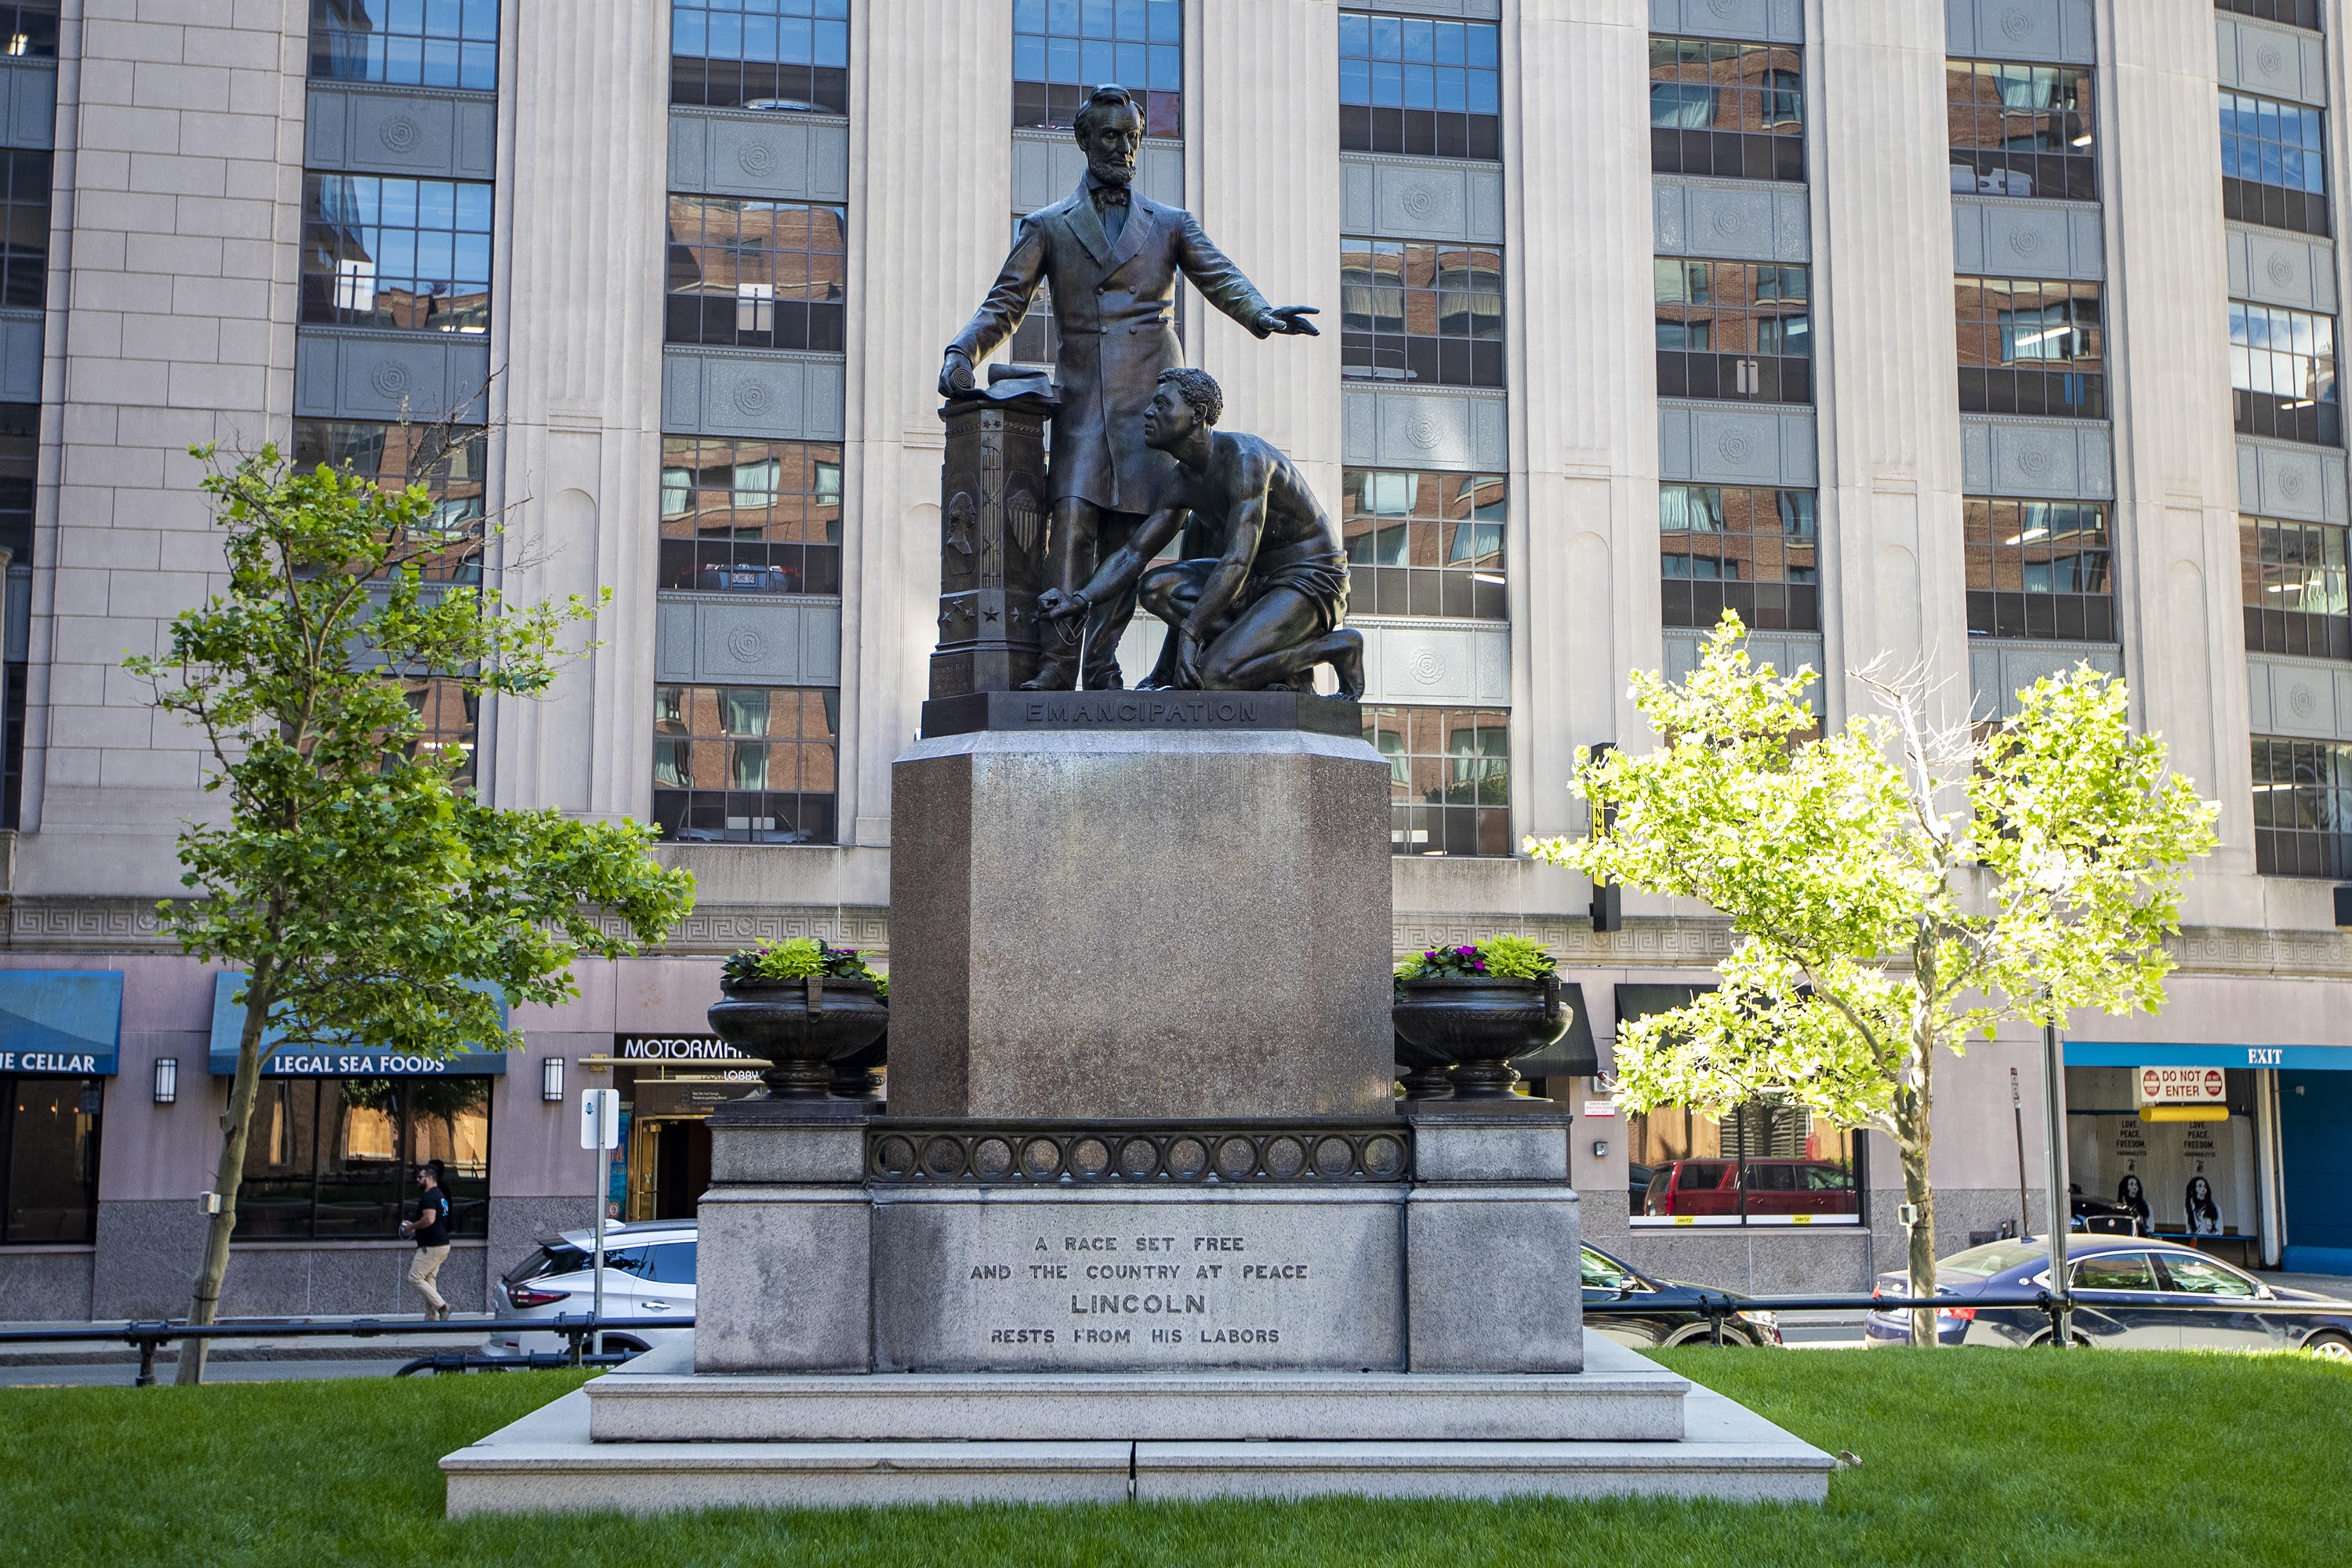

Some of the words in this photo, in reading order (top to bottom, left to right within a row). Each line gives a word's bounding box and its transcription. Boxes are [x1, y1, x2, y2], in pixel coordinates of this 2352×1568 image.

[1025, 701, 1258, 721] EMANCIPATION
[21, 1053, 96, 1073] CELLAR
[2248, 1048, 2283, 1065] EXIT
[274, 1056, 334, 1073] LEGAL
[339, 1056, 374, 1073] SEA
[379, 1056, 445, 1073] FOODS
[724, 1070, 758, 1081] LOBBY
[2162, 1070, 2176, 1082] DO
[2180, 1070, 2201, 1083] NOT
[2165, 1086, 2200, 1097] ENTER
[1035, 1236, 1048, 1250] A
[1065, 1236, 1117, 1251] RACE
[1135, 1237, 1175, 1251] SET
[1193, 1237, 1244, 1251] FREE
[970, 1265, 1011, 1279] AND
[1029, 1265, 1068, 1279] THE
[1086, 1265, 1181, 1279] COUNTRY
[1196, 1265, 1222, 1279] AT
[1243, 1265, 1308, 1279] PEACE
[1071, 1294, 1205, 1314] LINCOLN
[991, 1329, 1055, 1344] RESTS
[1074, 1329, 1131, 1344] FROM
[1152, 1329, 1182, 1344] HIS
[1200, 1329, 1279, 1344] LABORS
